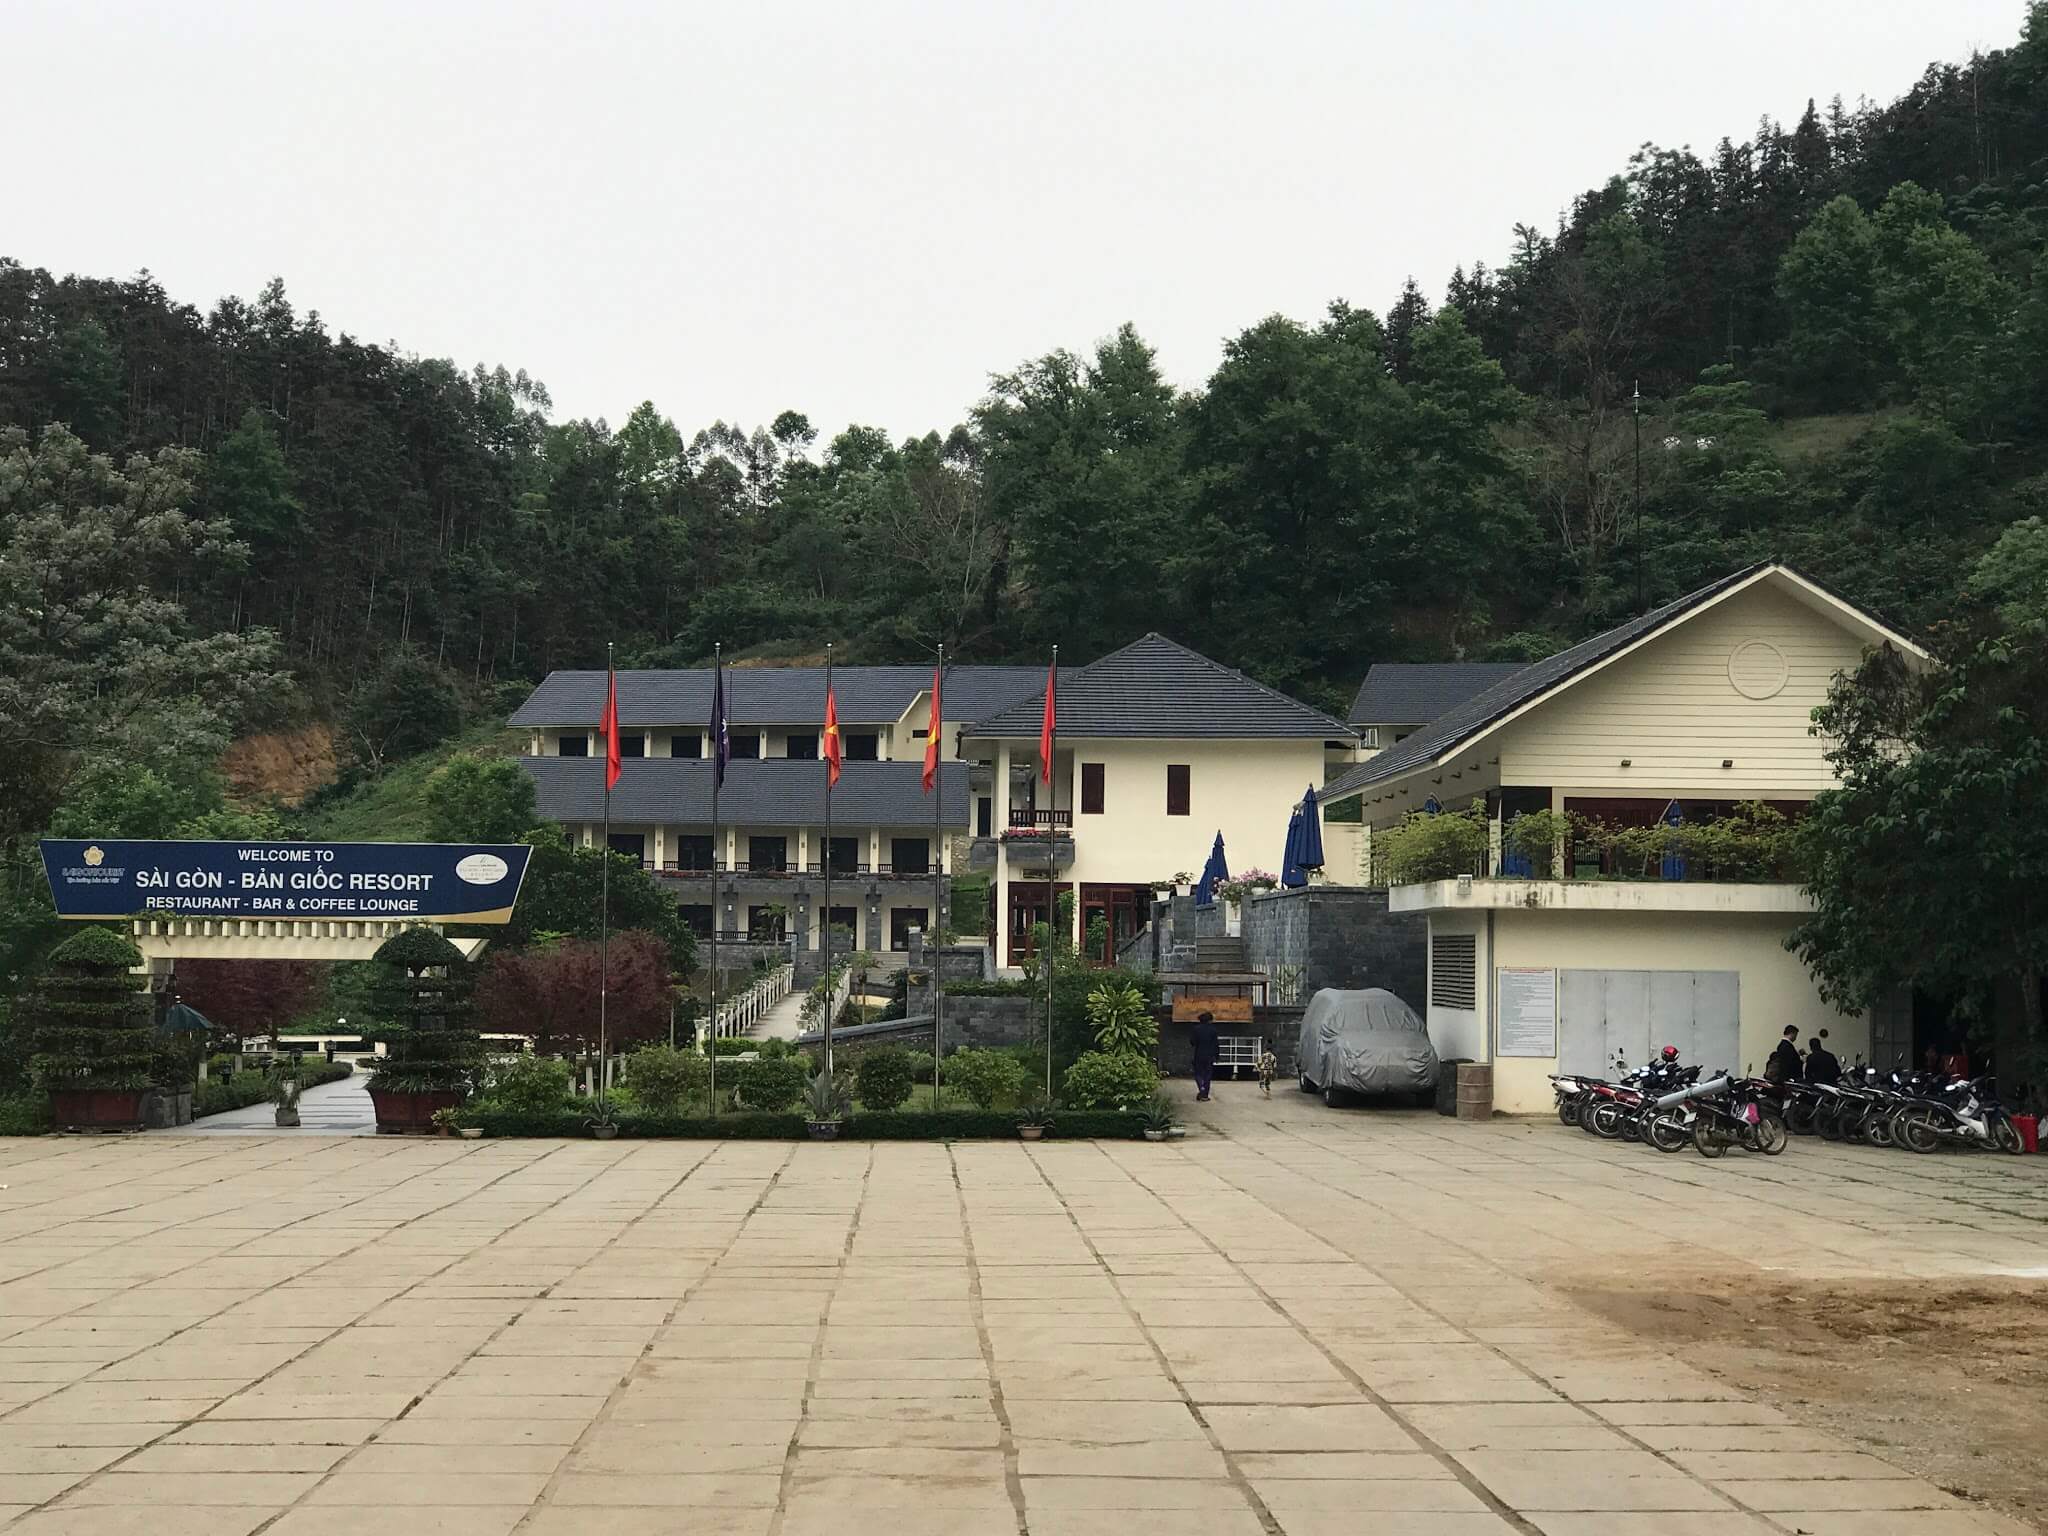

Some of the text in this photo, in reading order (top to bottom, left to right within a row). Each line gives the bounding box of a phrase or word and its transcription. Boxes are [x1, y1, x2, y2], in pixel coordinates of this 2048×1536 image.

[237, 849, 334, 862] WELCOME TO
[135, 866, 170, 889] SÀI
[175, 866, 222, 889] GÒN
[241, 867, 284, 890] BẢN
[290, 865, 344, 891] GIỐC
[349, 872, 434, 892] RESORT
[146, 896, 241, 910] RESTAURANT
[252, 897, 282, 910] BAR
[285, 898, 296, 910] &
[299, 897, 356, 911] COFFEE
[359, 898, 419, 912] LOUNGE
